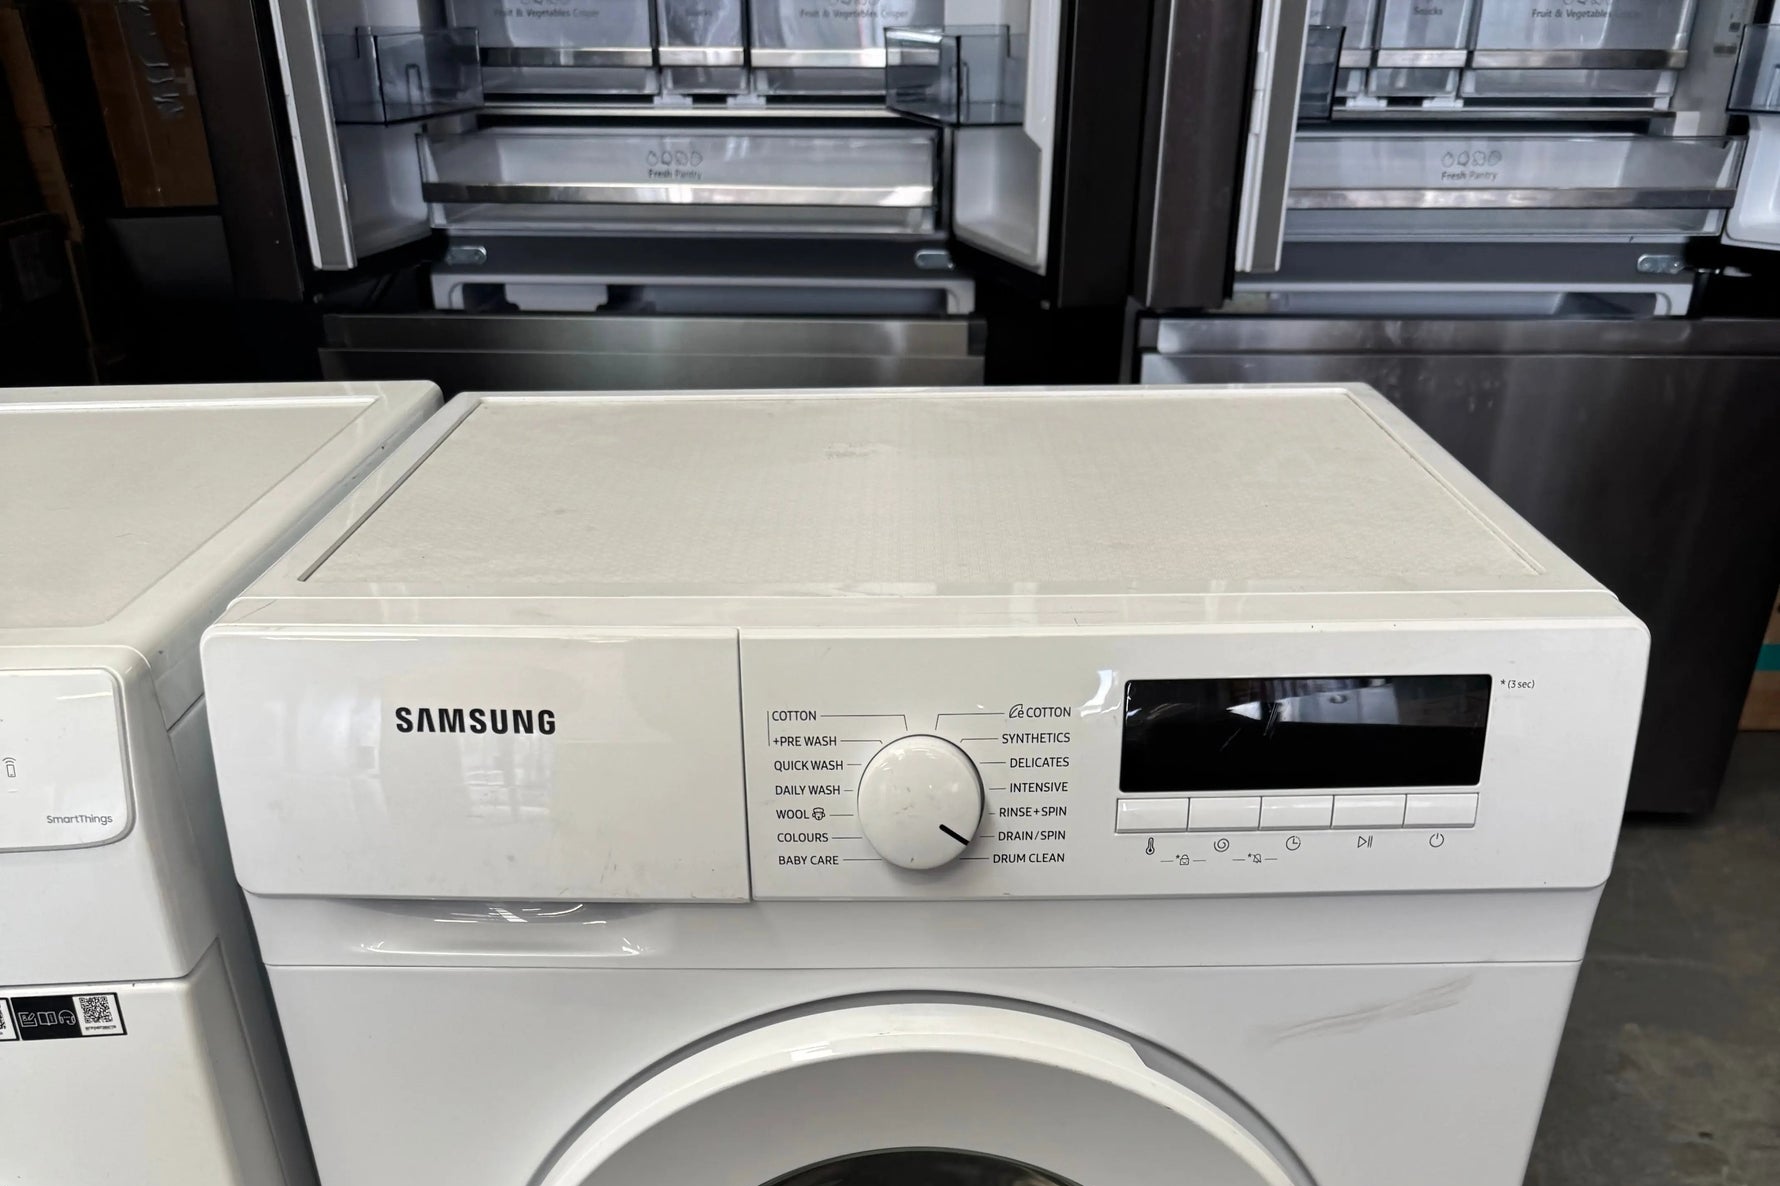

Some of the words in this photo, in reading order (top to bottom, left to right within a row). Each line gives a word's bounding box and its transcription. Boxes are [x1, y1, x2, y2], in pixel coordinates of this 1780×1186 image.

[1532, 9, 1552, 18] Fruit
[1555, 9, 1562, 18] &
[1566, 8, 1611, 20] Vegetables
[648, 168, 672, 178] Fresh
[1441, 171, 1466, 180] Fresh
[1469, 171, 1497, 181] Pantry
[771, 710, 817, 721] COTTON
[1026, 706, 1072, 718] COTTON
[395, 706, 556, 735] SAMSUNG
[804, 735, 837, 746] WASH
[1002, 732, 1071, 744] SYNTHETICS
[774, 760, 809, 773] QUICK
[810, 760, 844, 771] WASH
[1010, 756, 1070, 768] DELICATES
[775, 785, 806, 795] DAILY
[808, 785, 841, 795] WASH
[1010, 781, 1069, 793] INTENSIVE
[46, 814, 113, 825] SmartThings
[776, 809, 810, 820] WOOL
[777, 832, 829, 843] COLOURS
[778, 855, 808, 865] BABY
[810, 855, 839, 866] CARE
[993, 853, 1026, 864] DRUM
[1028, 853, 1065, 863] CLEAN
